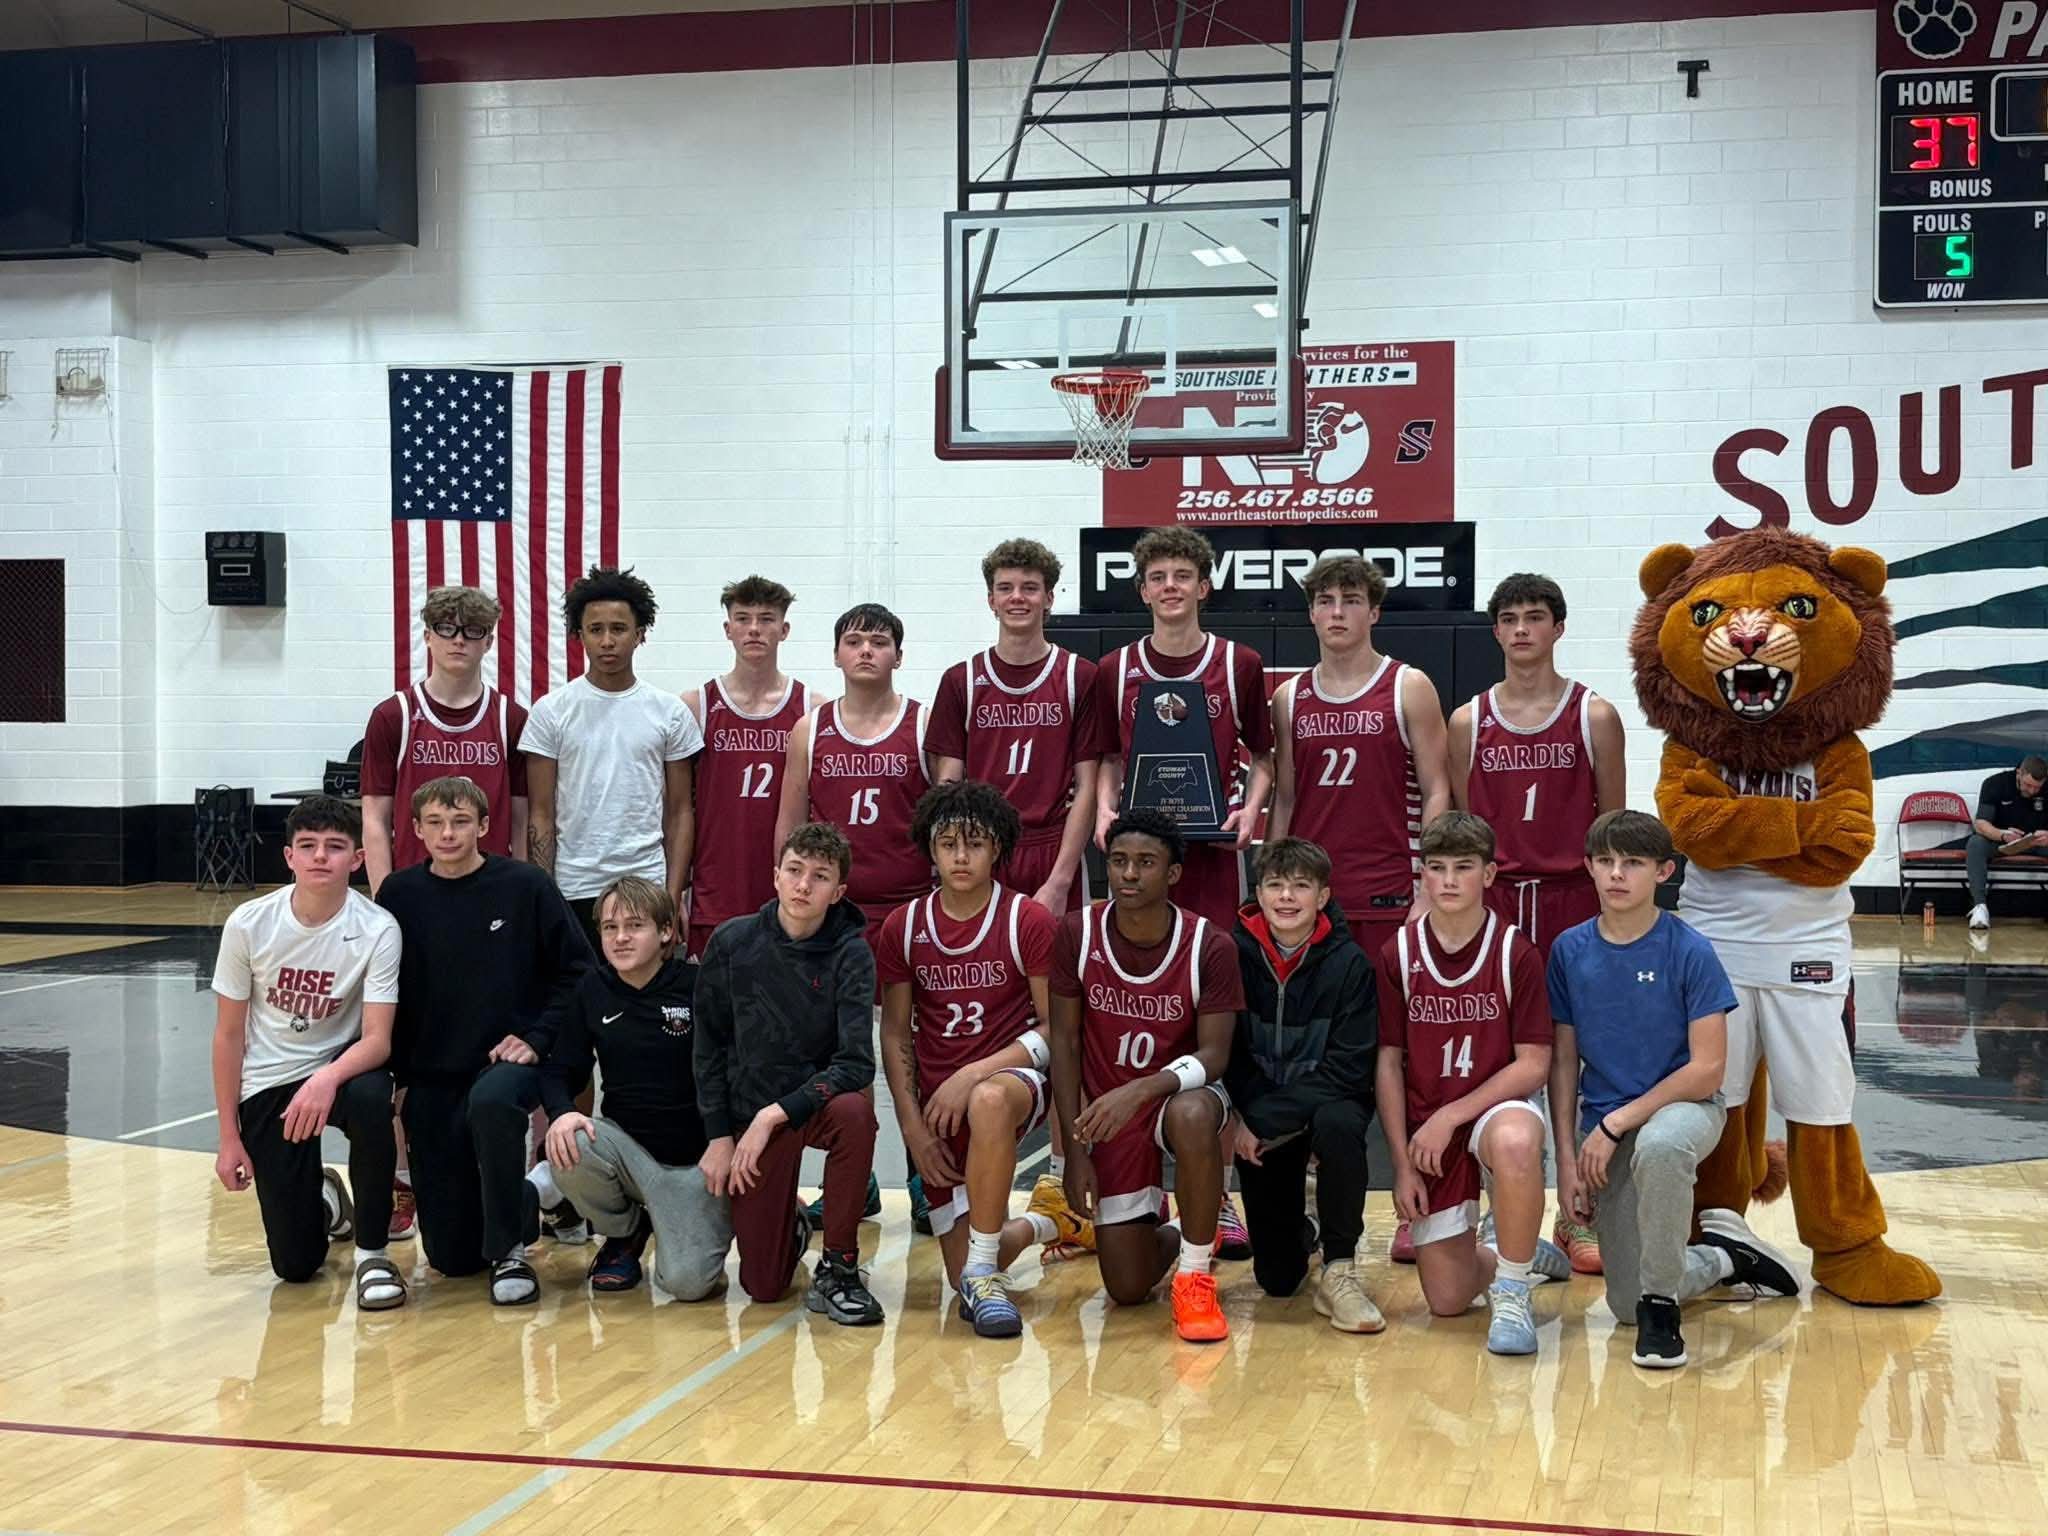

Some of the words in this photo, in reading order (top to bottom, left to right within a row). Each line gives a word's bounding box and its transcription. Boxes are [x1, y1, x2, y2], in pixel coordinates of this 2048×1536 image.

[1898, 80, 1973, 106] HOME
[1909, 116, 1977, 169] 37
[1929, 179, 1992, 198] BONUS
[1913, 213, 1972, 233] FOULS
[1946, 236, 1971, 276] 5
[1927, 283, 1965, 299] WON
[1354, 346, 1378, 360] for
[1384, 344, 1409, 359] the
[1176, 369, 1266, 388] SOUTHSIDE
[1176, 487, 1374, 509] 256.467.8566
[1176, 508, 1379, 523] www.northeastorthopedics.com
[976, 703, 1063, 728] SARDIS
[1297, 711, 1384, 739] SARDIS
[412, 740, 500, 766] SARDIS
[714, 728, 791, 752] SARDI
[821, 753, 908, 777] SARDIS
[1006, 738, 1033, 775] 11
[1318, 747, 1358, 786] 22
[1481, 743, 1576, 773] SARDIS
[739, 763, 774, 798] 12
[848, 788, 881, 825] 15
[1521, 782, 1538, 821] 1
[277, 967, 335, 995] RISE
[915, 961, 1008, 990] SARDIS
[266, 987, 344, 1020] ABOVE
[1089, 983, 1184, 1021] SARDIS
[1408, 993, 1499, 1023] SARDIS
[941, 1001, 985, 1037] 23
[1114, 1031, 1155, 1069] 10
[1439, 1035, 1473, 1078] 14
